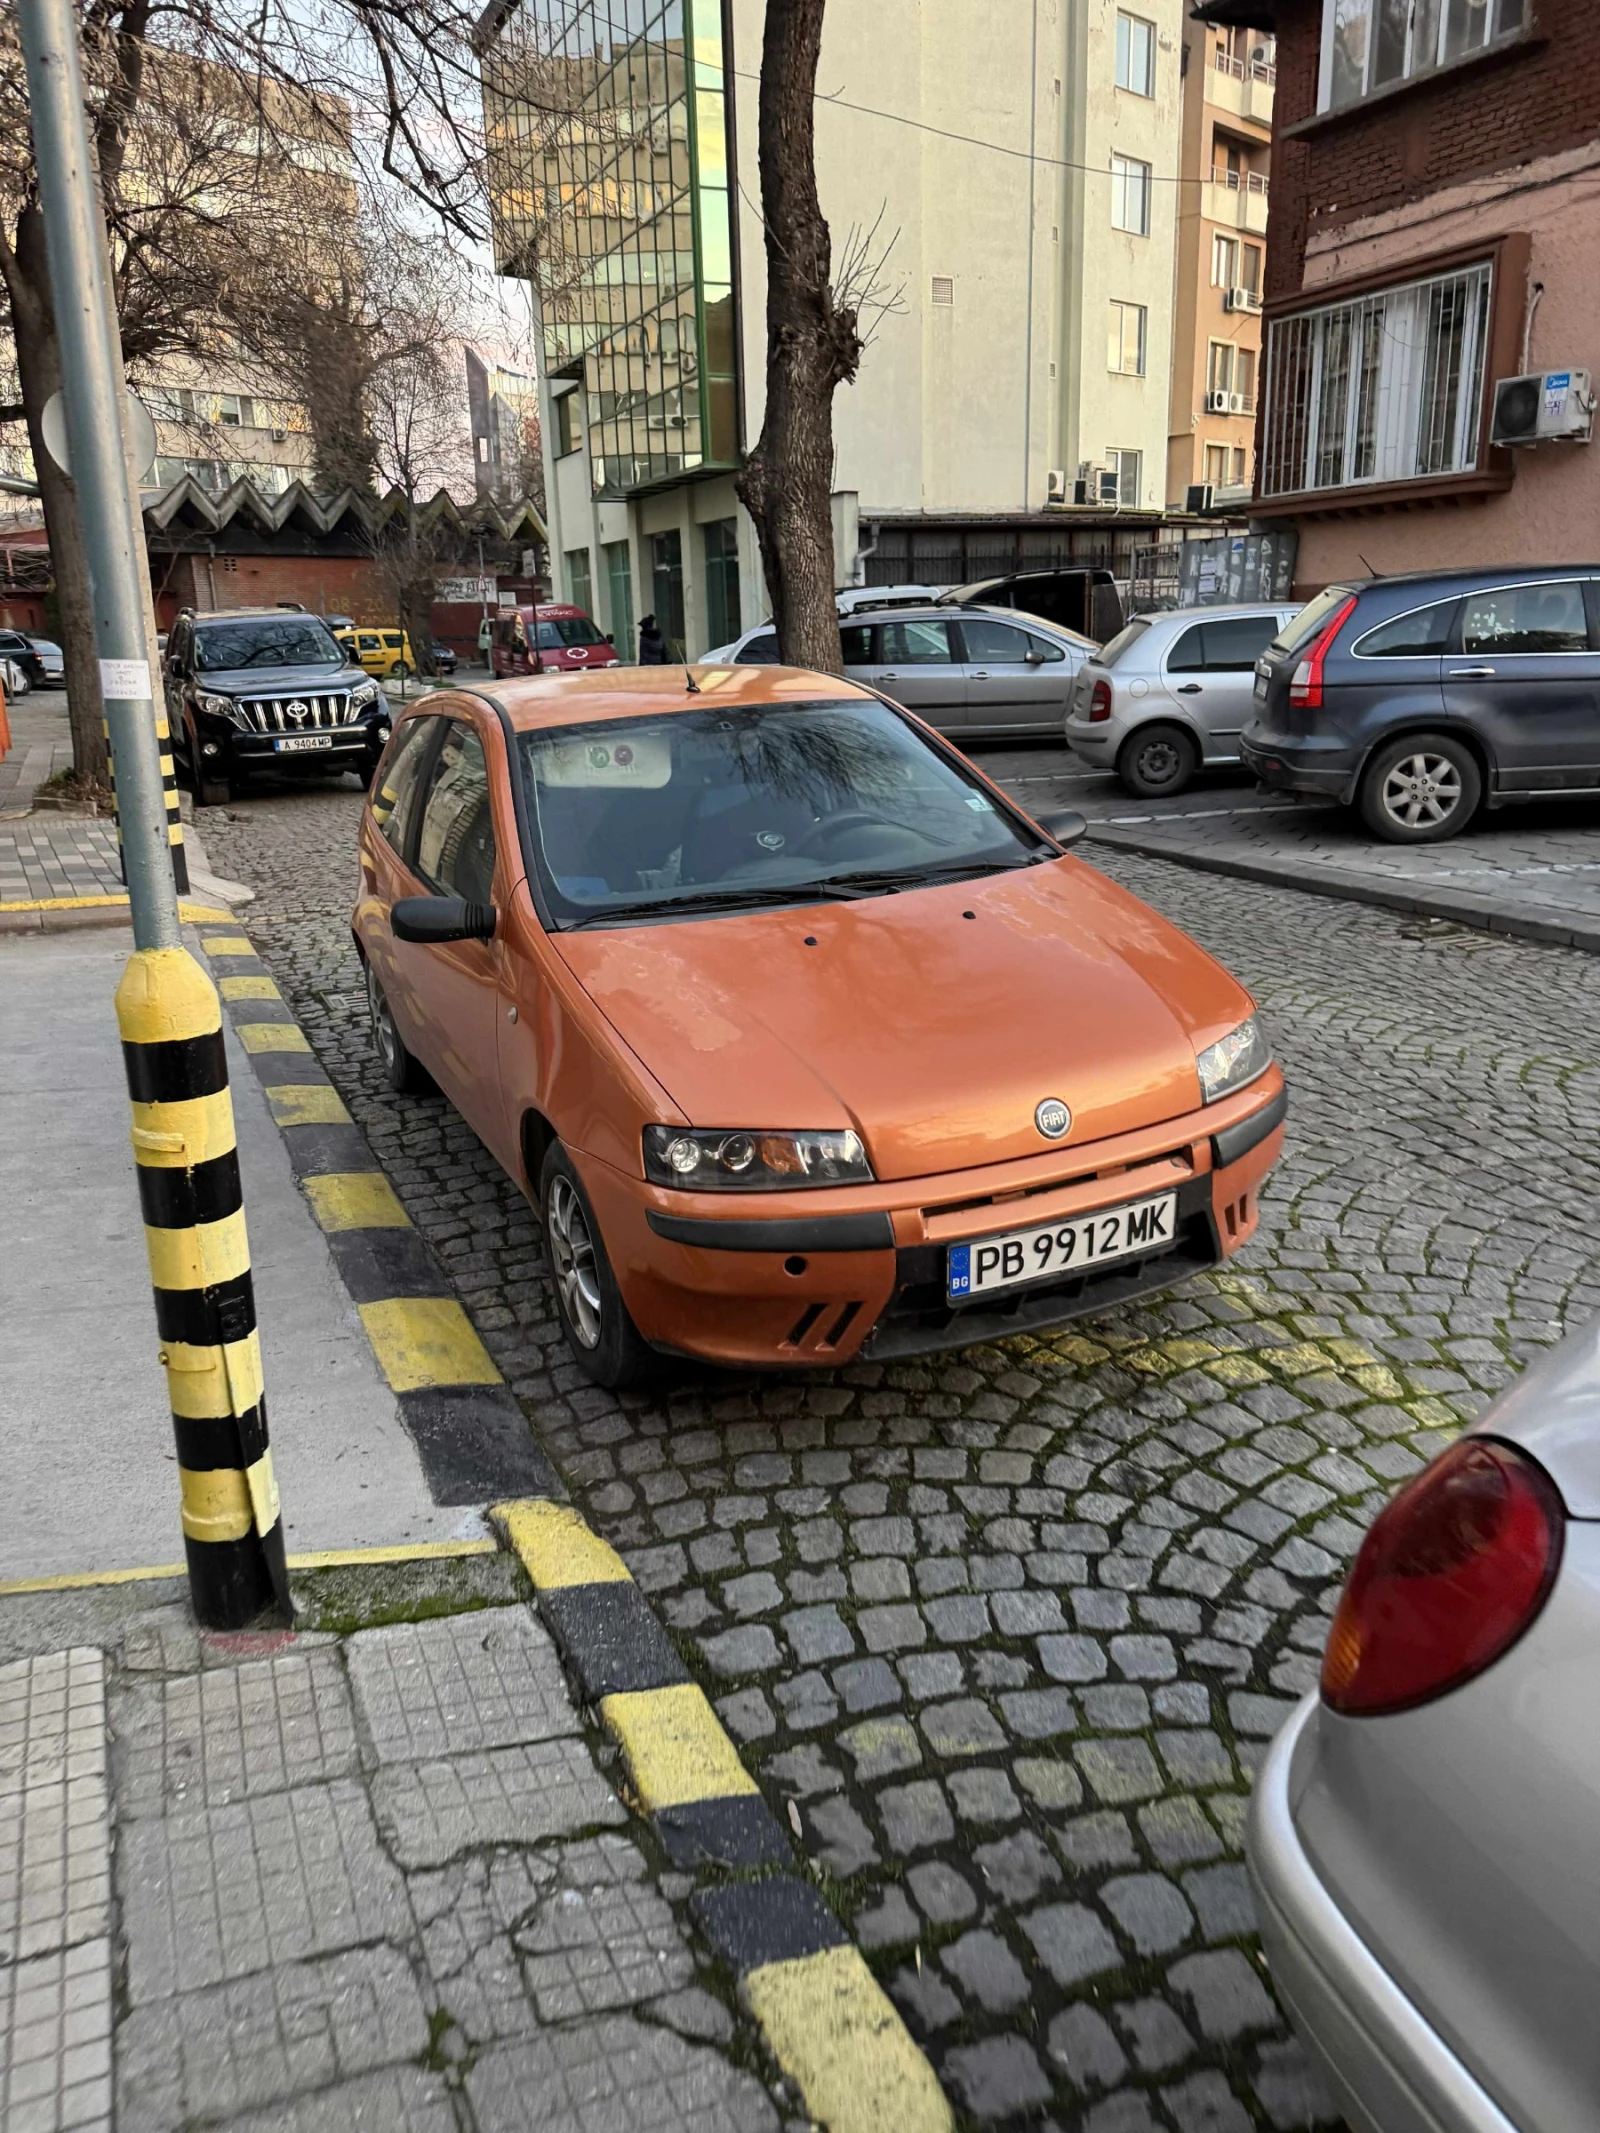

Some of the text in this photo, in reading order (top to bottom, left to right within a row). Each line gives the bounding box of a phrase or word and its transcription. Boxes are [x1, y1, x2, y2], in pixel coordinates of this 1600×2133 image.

[285, 741, 291, 750] A
[294, 739, 317, 749] 9404
[1042, 1111, 1065, 1128] FIAT
[976, 1201, 1169, 1285] PB 9912 MK
[952, 1277, 968, 1290] BG
